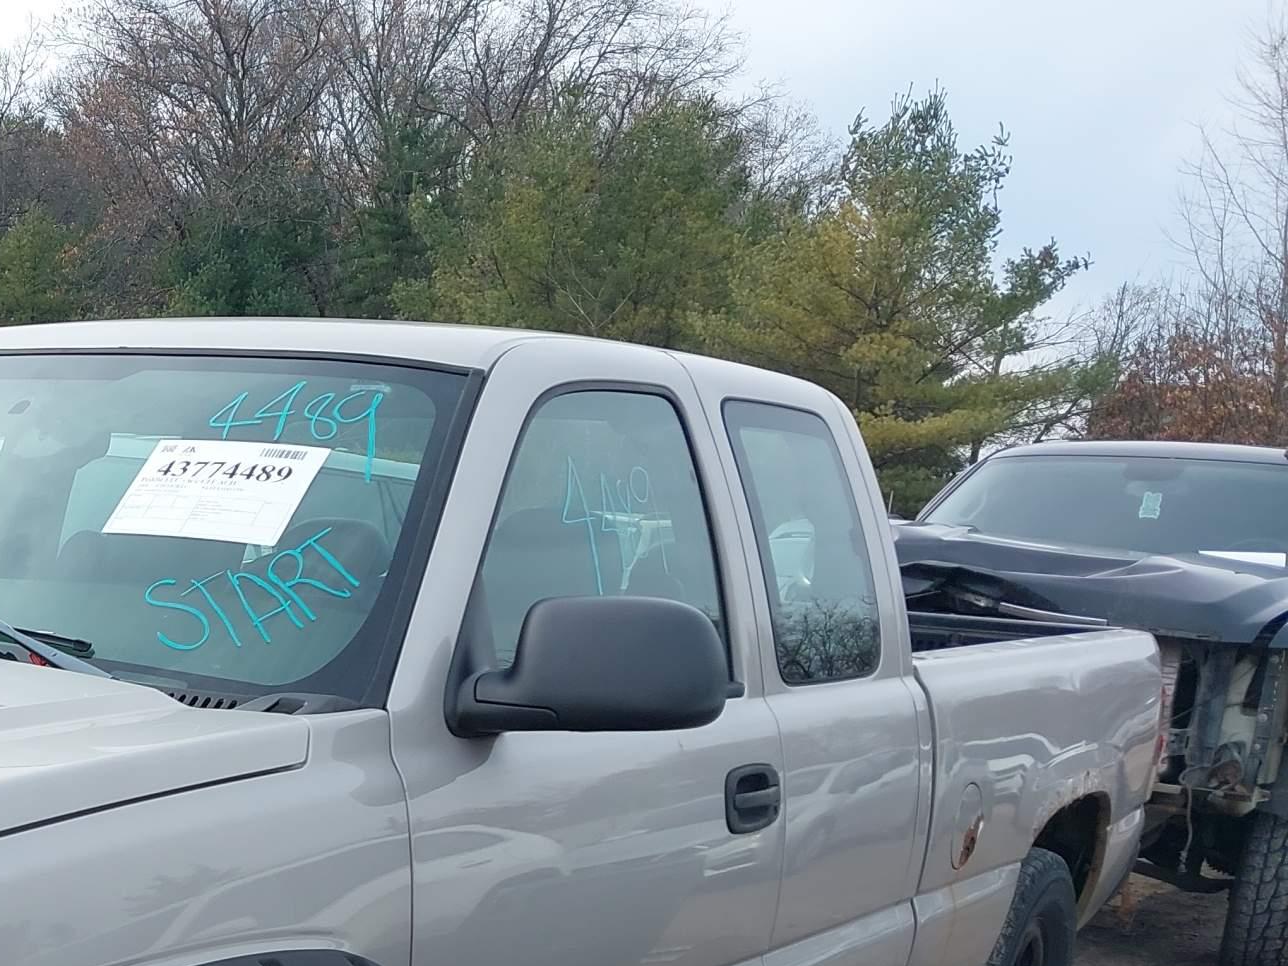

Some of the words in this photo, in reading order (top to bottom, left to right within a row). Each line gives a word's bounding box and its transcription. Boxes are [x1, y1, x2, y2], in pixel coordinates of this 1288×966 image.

[157, 459, 294, 484] 43774489
[209, 381, 384, 483] 4489
[144, 527, 360, 650] START
